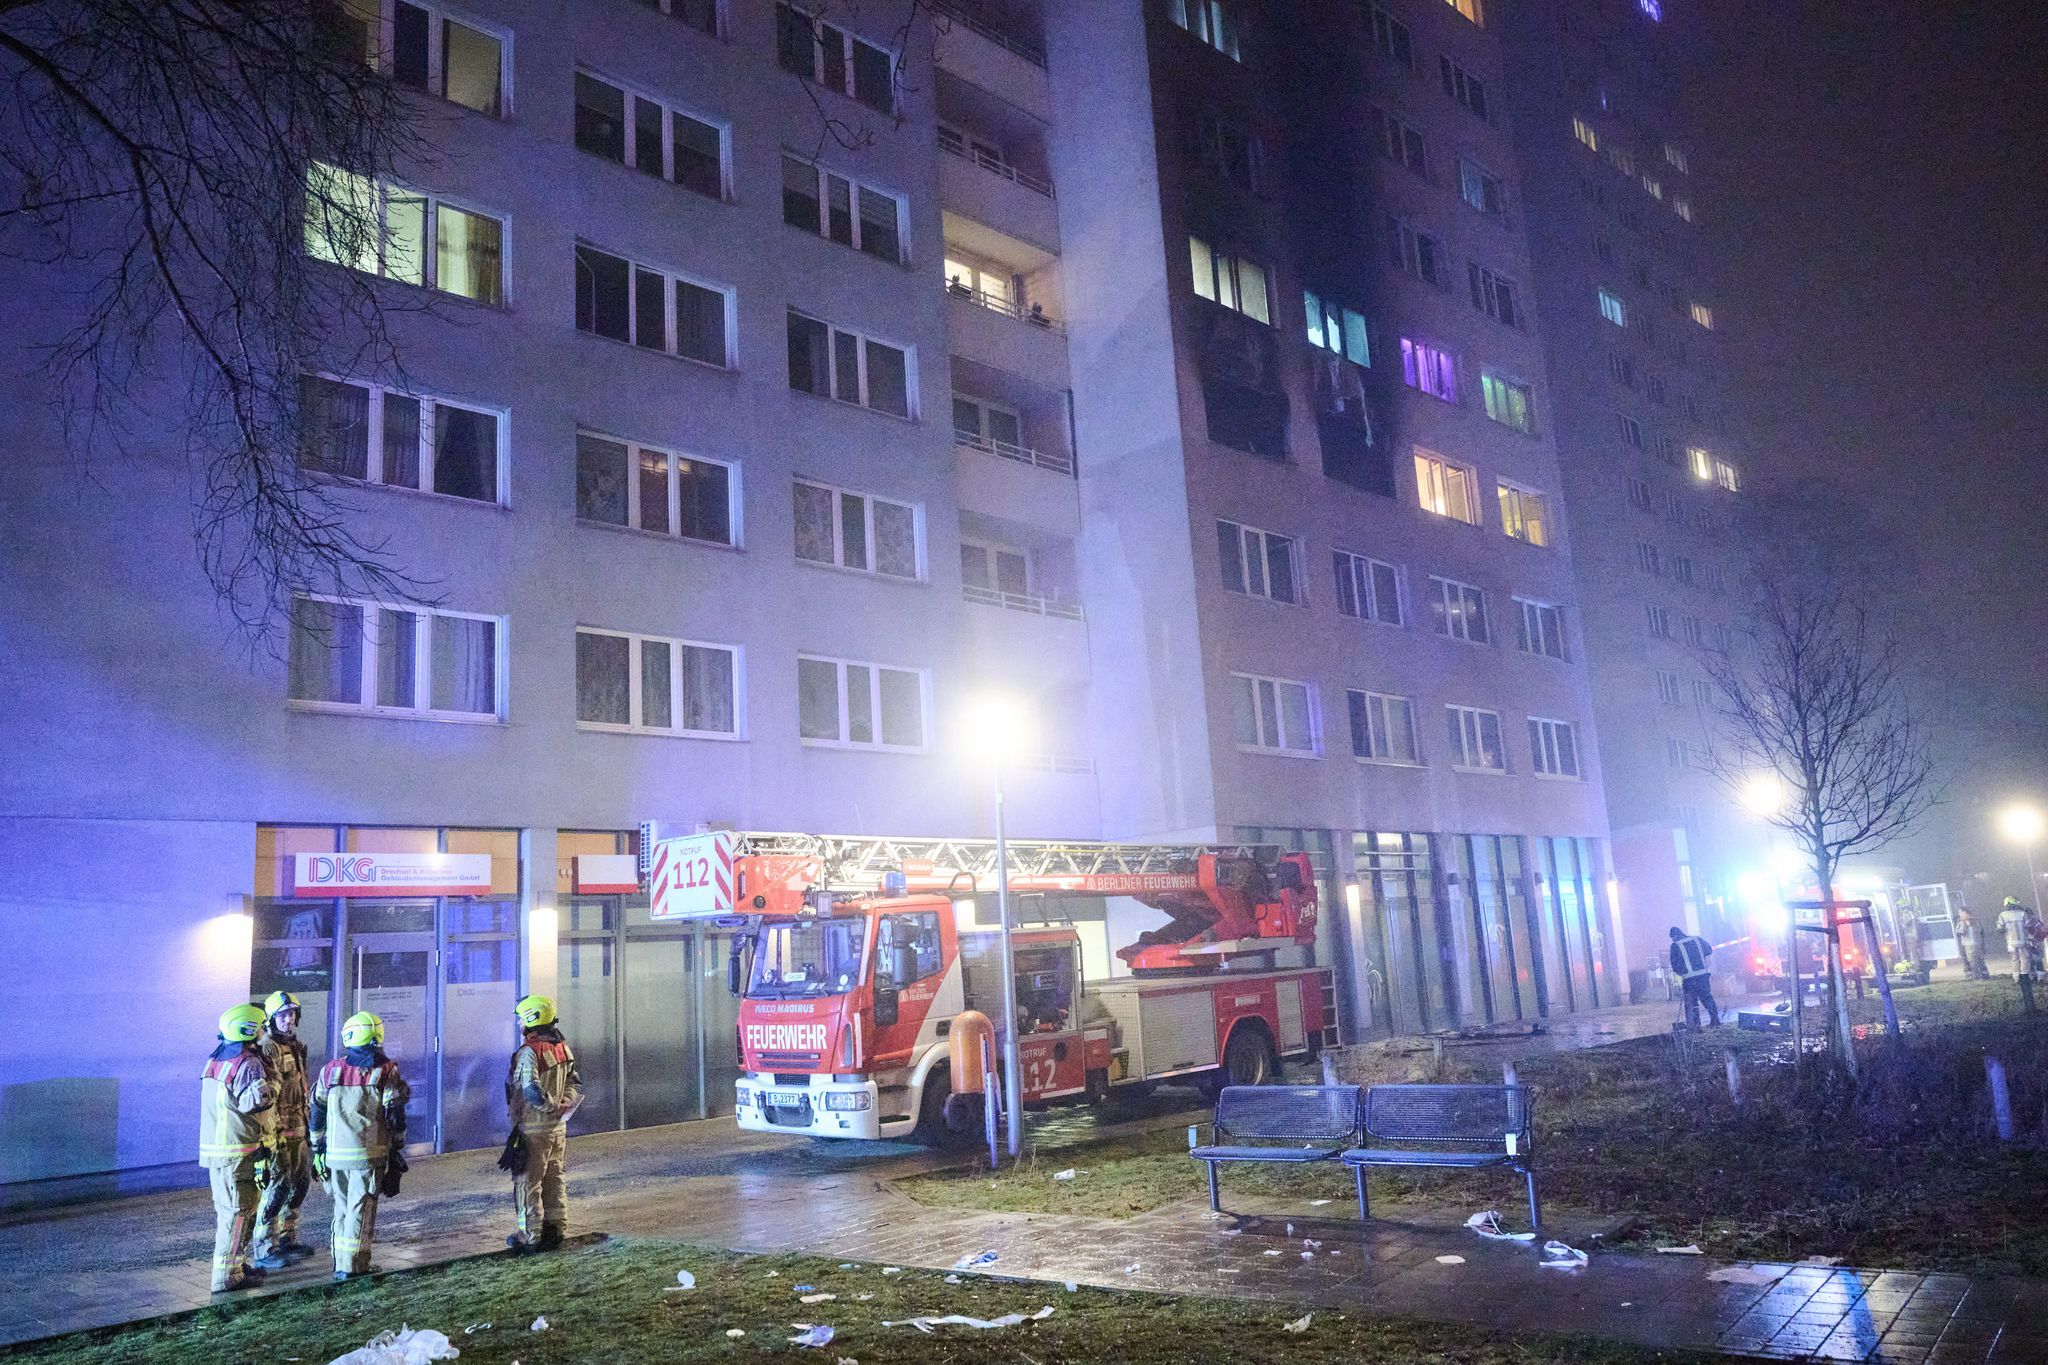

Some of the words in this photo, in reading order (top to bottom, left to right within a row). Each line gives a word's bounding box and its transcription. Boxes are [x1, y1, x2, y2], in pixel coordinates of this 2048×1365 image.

[680, 846, 702, 855] NOTRUF
[309, 857, 377, 883] DKG
[673, 857, 709, 889] 112
[1098, 877, 1142, 890] BERLINER
[1144, 876, 1197, 890] FEUERWEHR
[755, 1004, 776, 1014] IVECO
[777, 1003, 815, 1013] MAGIRUS
[746, 1024, 828, 1050] FEUERWEHR
